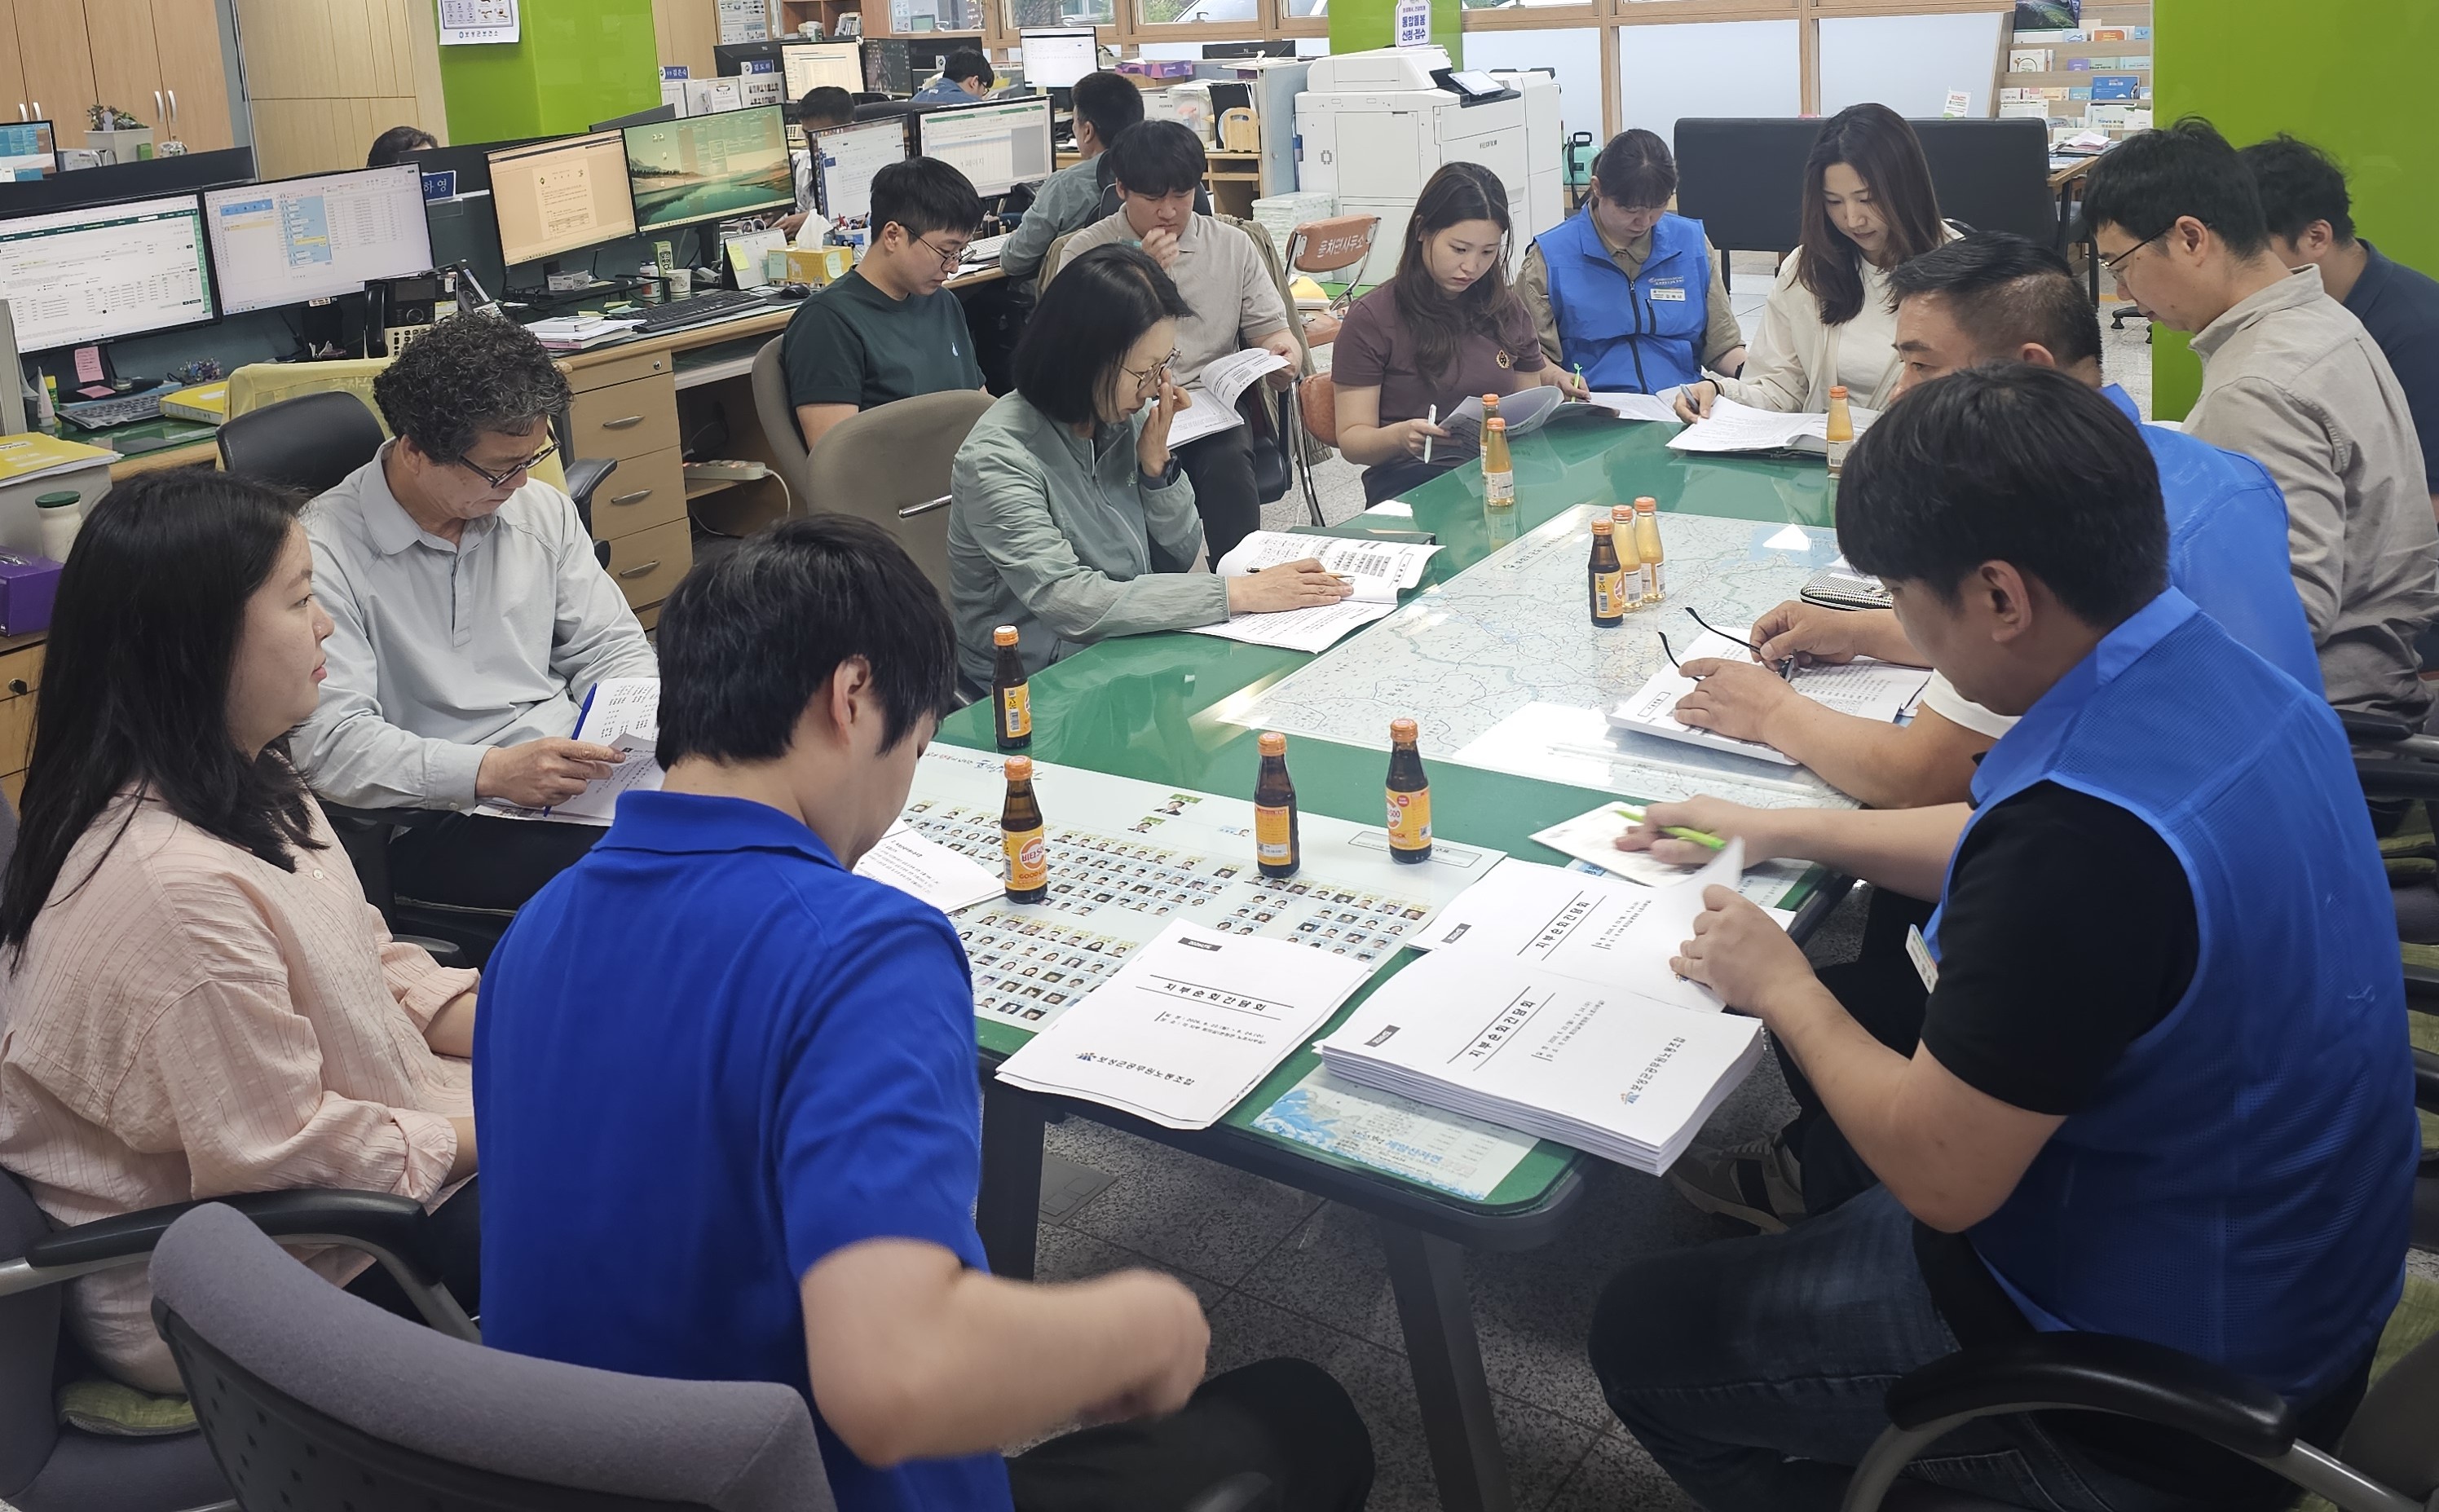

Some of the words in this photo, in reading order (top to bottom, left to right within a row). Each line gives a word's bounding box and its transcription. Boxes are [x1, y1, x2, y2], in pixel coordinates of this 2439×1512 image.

[1402, 14, 1426, 28] 통합돌봄
[1162, 982, 1268, 1012] 지부순회간담회
[1469, 1000, 1536, 1057] 지부순회간담회
[1096, 1056, 1195, 1086] 보성군공무원노동조합
[1630, 1036, 1686, 1091] 보성군공무원노동조합
